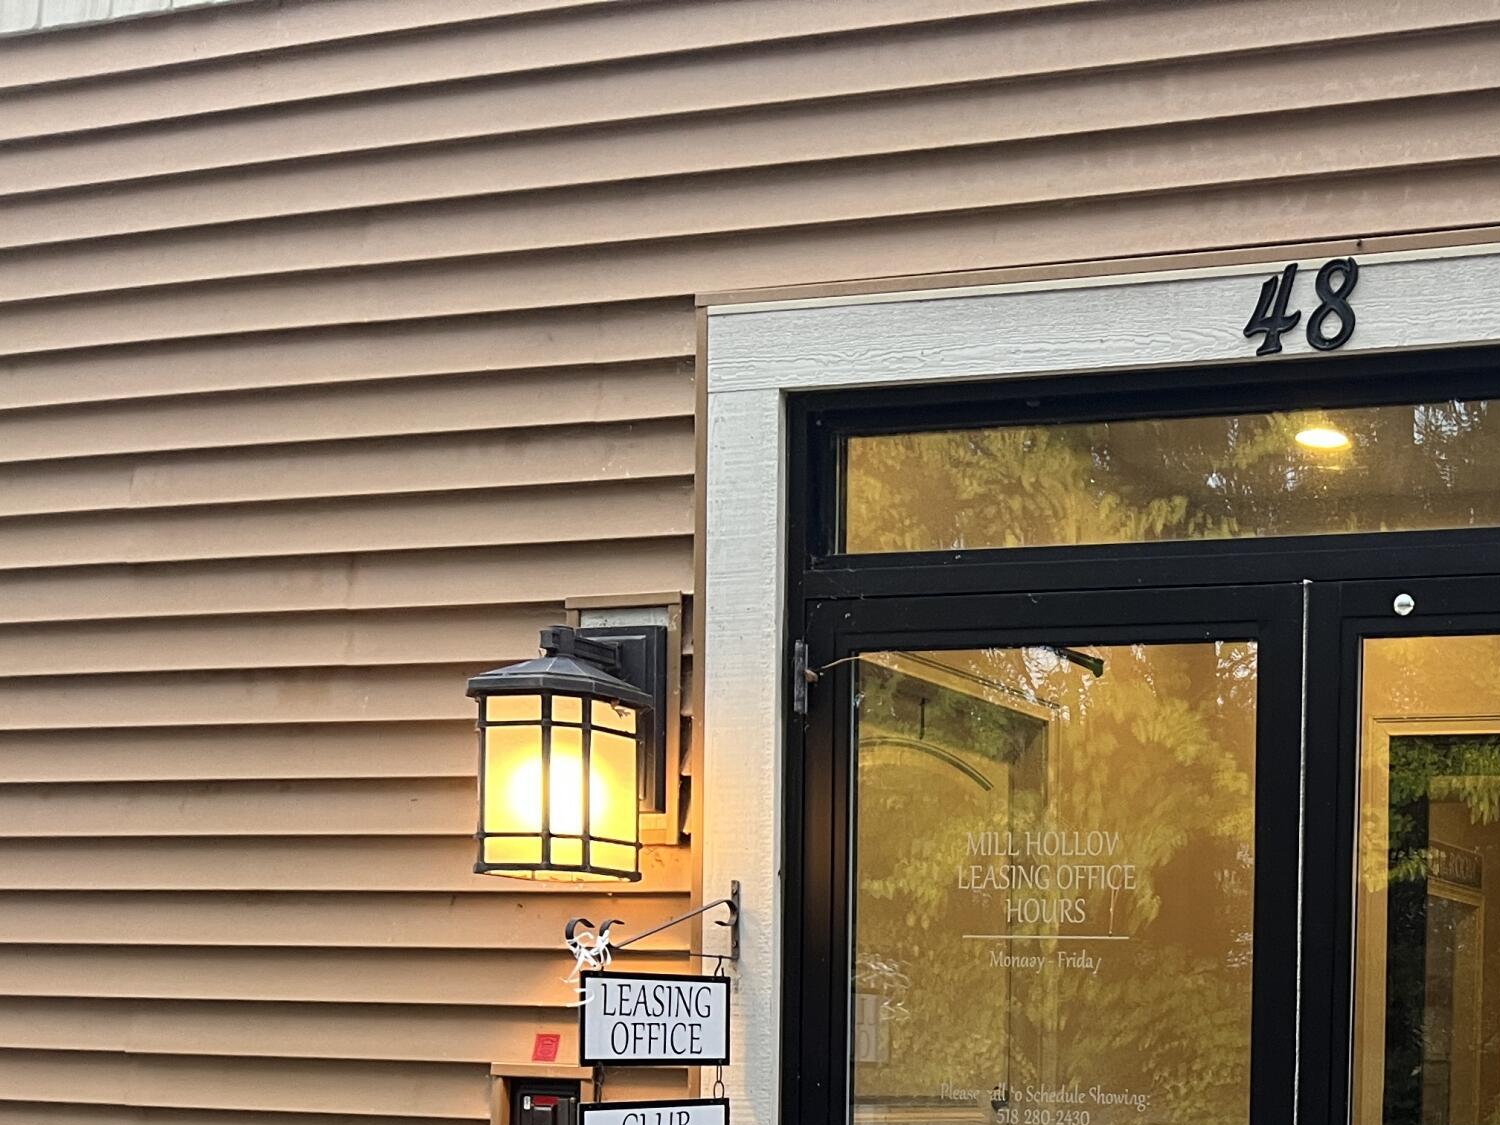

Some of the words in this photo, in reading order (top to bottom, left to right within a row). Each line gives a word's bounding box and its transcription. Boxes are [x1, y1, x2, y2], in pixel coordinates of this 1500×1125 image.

[1243, 257, 1359, 356] 48
[965, 831, 1020, 857] MILL
[957, 864, 1051, 890] LEASING
[1056, 864, 1137, 890] OFFICE
[1005, 898, 1087, 924] HOURS
[601, 983, 712, 1018] LEASING
[611, 1021, 703, 1056] OFFICE
[986, 1082, 1006, 1101] all
[1026, 1084, 1086, 1104] Schedule
[996, 1108, 1019, 1125] 518
